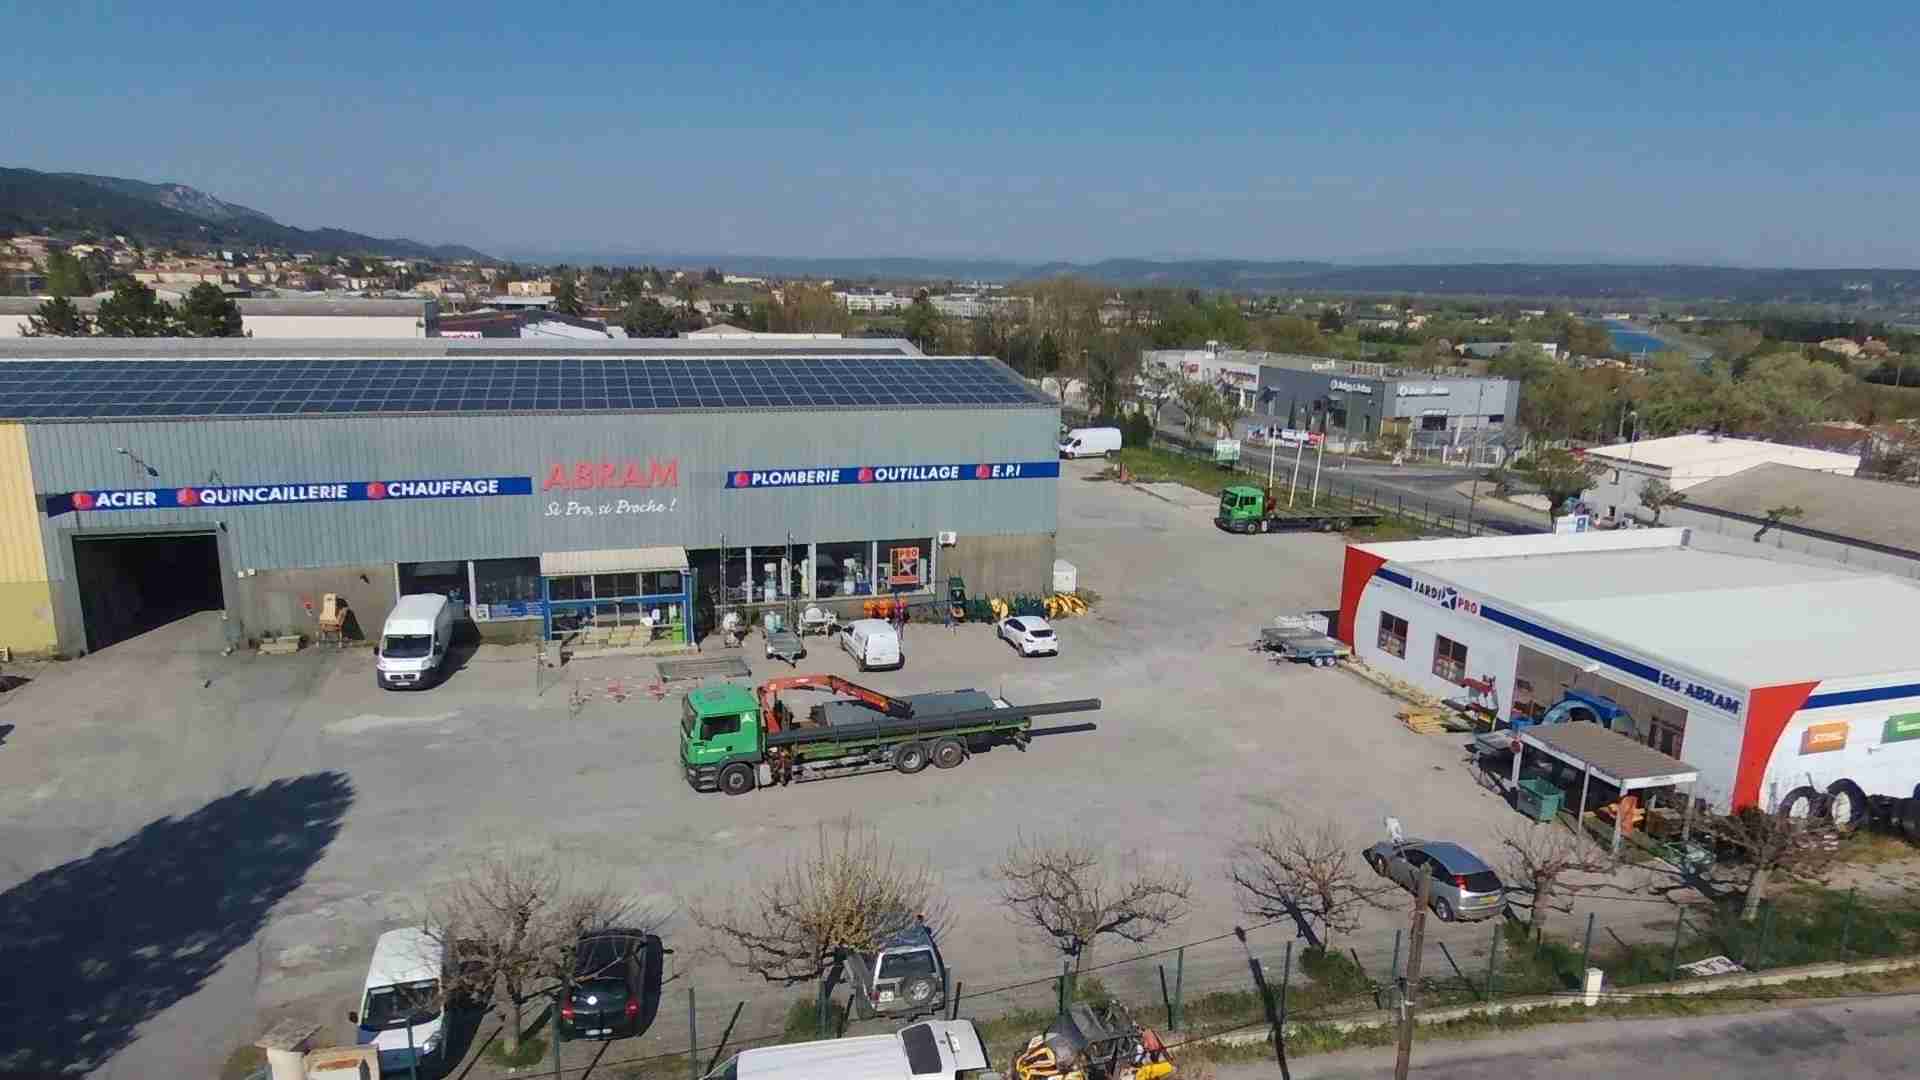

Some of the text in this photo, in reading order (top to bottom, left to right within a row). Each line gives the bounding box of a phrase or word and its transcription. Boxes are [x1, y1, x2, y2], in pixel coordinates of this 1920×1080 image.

[544, 459, 679, 491] ABRAM
[752, 464, 1021, 485] PLOMBERIE OUTILLAGE E.P.I
[96, 480, 498, 507] ACIER QUINCAILLERIE CHAUFFAGE
[615, 500, 666, 514] Proche
[1457, 598, 1478, 614] PRO
[1684, 683, 1739, 714] ABRAM
